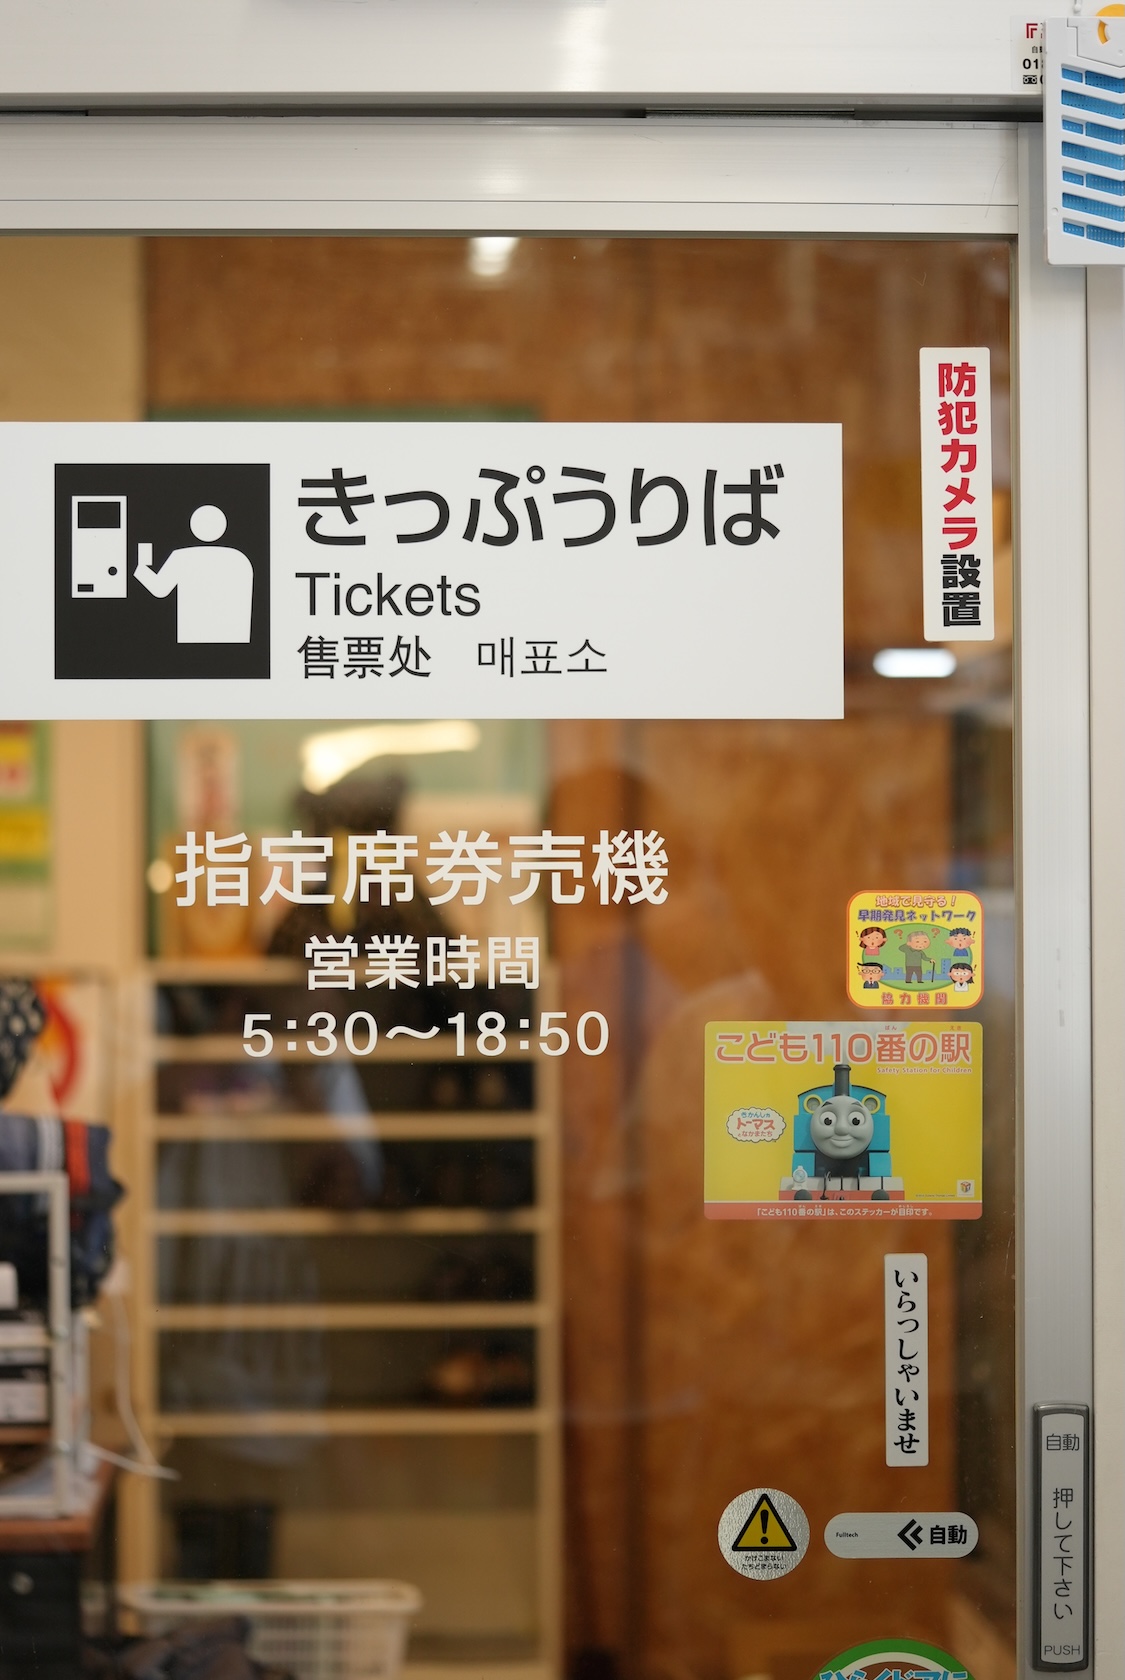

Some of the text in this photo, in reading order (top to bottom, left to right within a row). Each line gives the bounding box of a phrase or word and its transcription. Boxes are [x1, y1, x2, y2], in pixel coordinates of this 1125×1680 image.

[1023, 58, 1043, 69] 01
[298, 463, 785, 548] きっぷうりば
[938, 362, 981, 627] 防犯カメラ設置
[295, 572, 481, 617] Tickets
[297, 635, 607, 679] 售票处 매표소
[174, 829, 669, 906] 指定席券売機
[858, 910, 976, 922] 早期発見ネットワーク
[304, 934, 540, 990] 営業時間
[716, 1032, 970, 1063] こども110番の駅
[737, 1118, 775, 1130] トーマス
[1046, 1433, 1080, 1451] 自動
[930, 1525, 967, 1545] 自動
[1053, 1487, 1073, 1620] 押して下さい
[1044, 1645, 1081, 1656] PUSH
